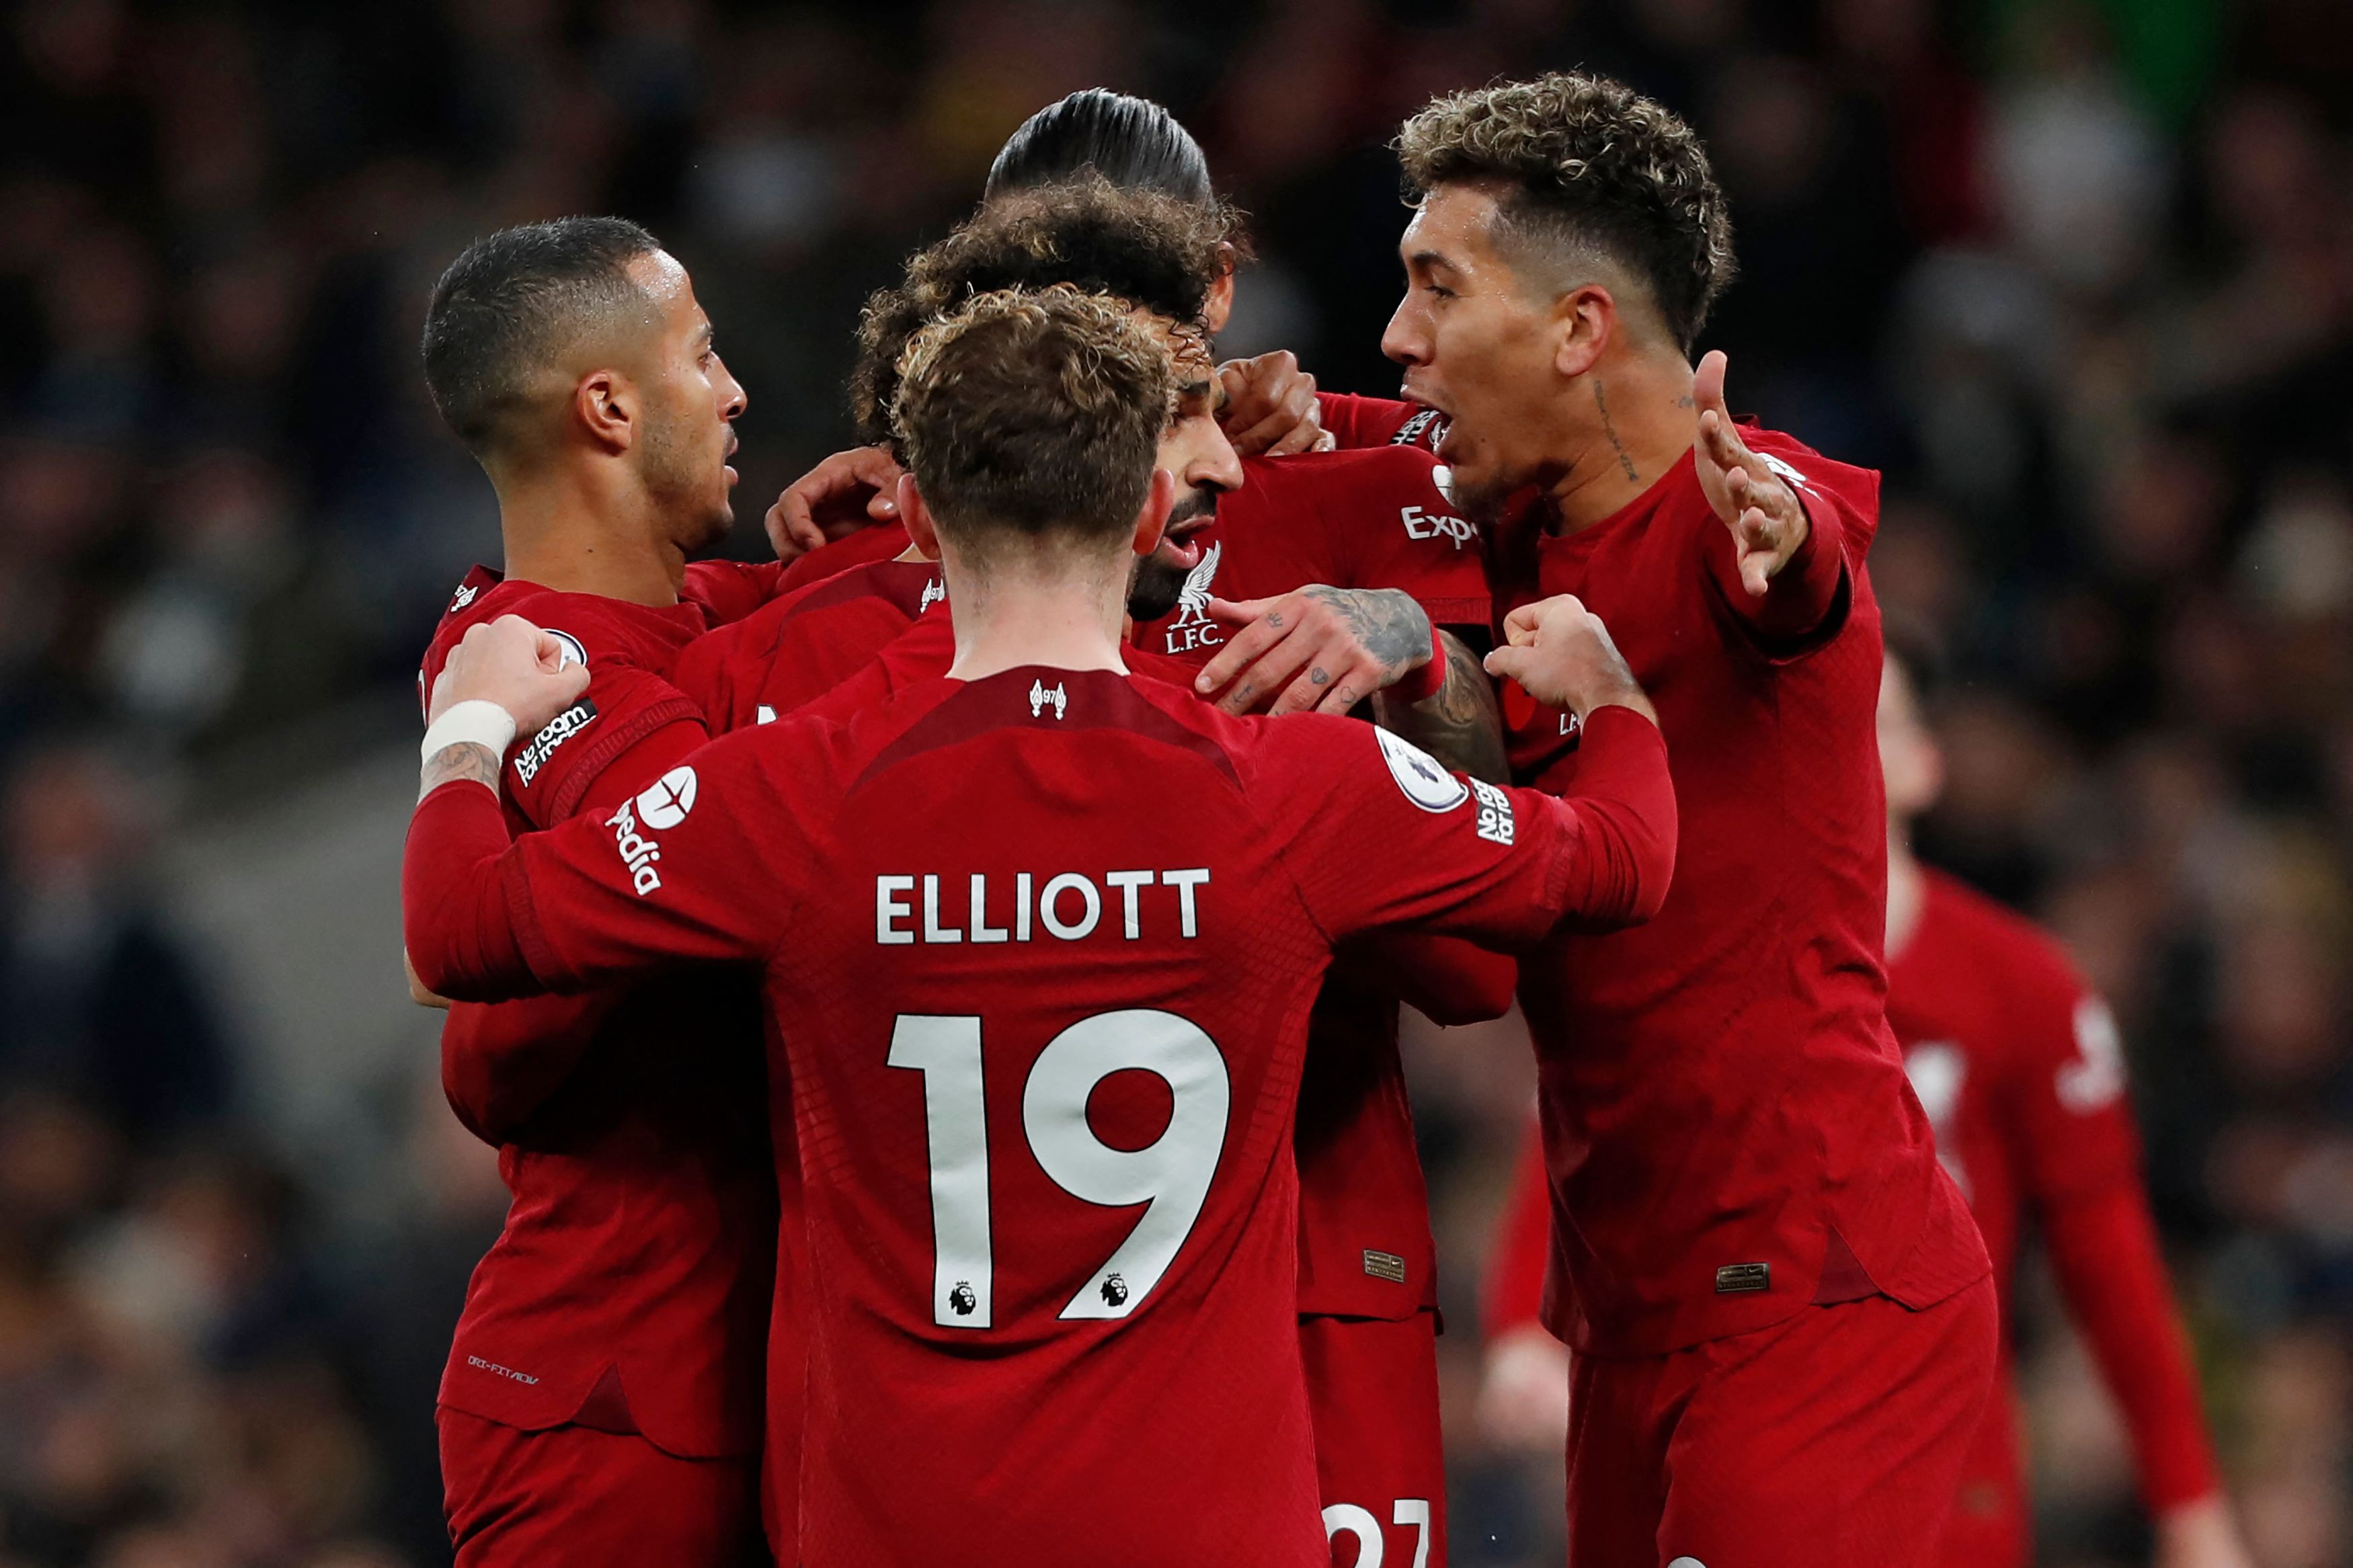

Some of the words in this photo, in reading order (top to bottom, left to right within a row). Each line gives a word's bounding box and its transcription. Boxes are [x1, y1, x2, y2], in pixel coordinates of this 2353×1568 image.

[1165, 624, 1224, 654] L.F.C.
[1043, 689, 1056, 704] 97
[514, 745, 535, 775] No
[534, 706, 588, 748] room
[1468, 776, 1496, 808] roo
[604, 796, 662, 897] pedia
[1478, 809, 1497, 841] No
[877, 868, 1210, 944] ELLIOTT
[886, 1007, 1230, 1329] 19
